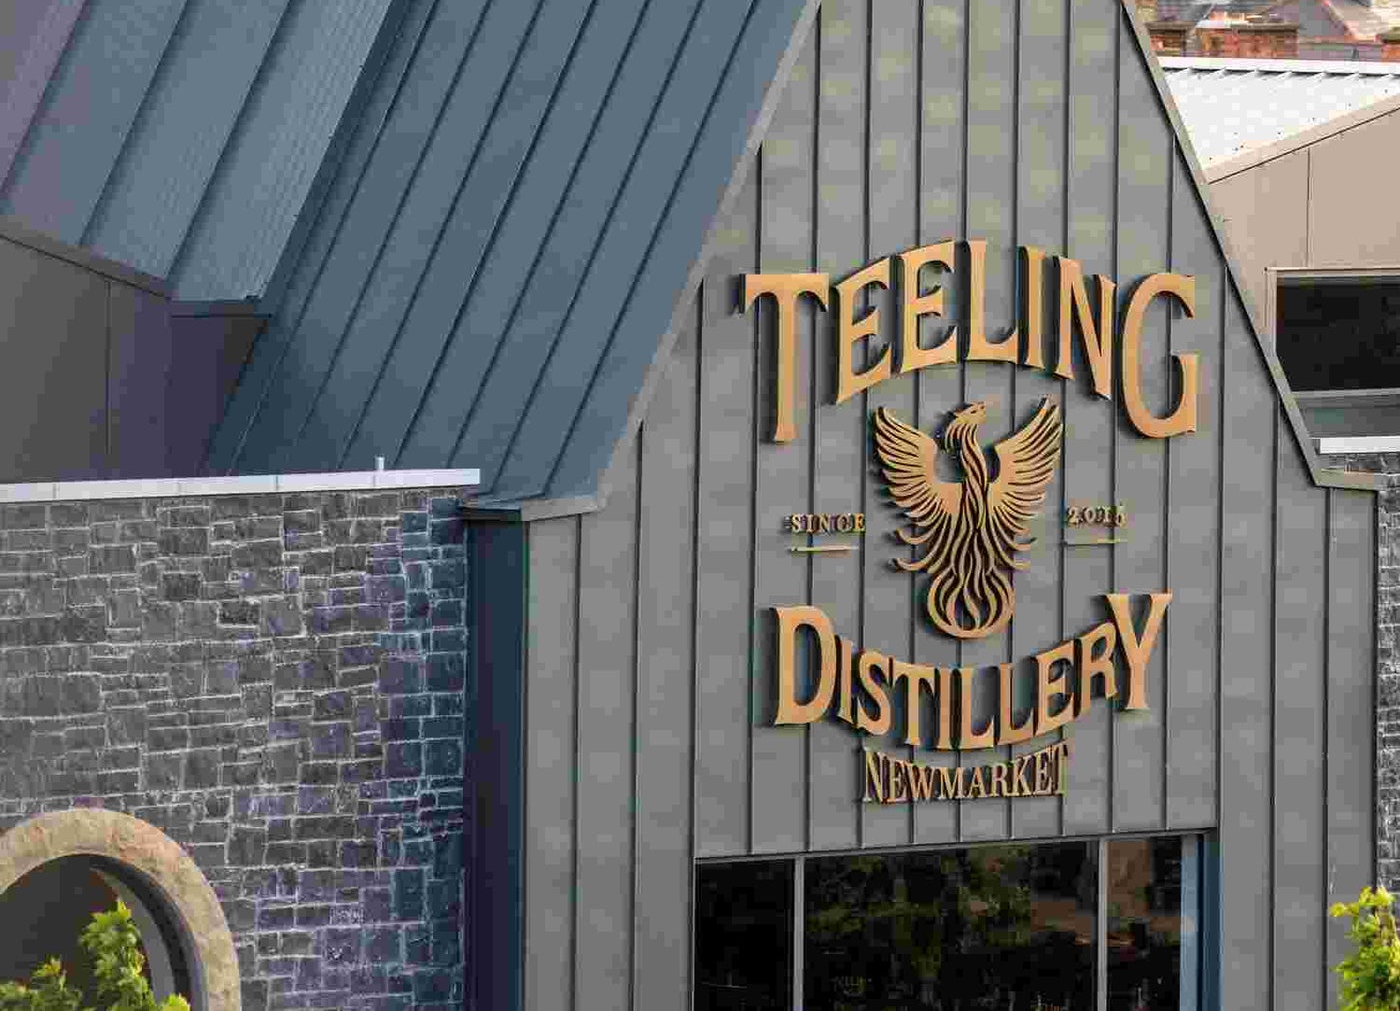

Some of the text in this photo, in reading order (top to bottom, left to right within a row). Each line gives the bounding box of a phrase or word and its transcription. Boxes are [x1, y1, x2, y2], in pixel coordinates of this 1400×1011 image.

[741, 237, 1200, 442] TEELING
[790, 512, 866, 534] SINCE
[772, 592, 1173, 751] DISTILLERY
[862, 743, 1070, 804] NEWMARKET
